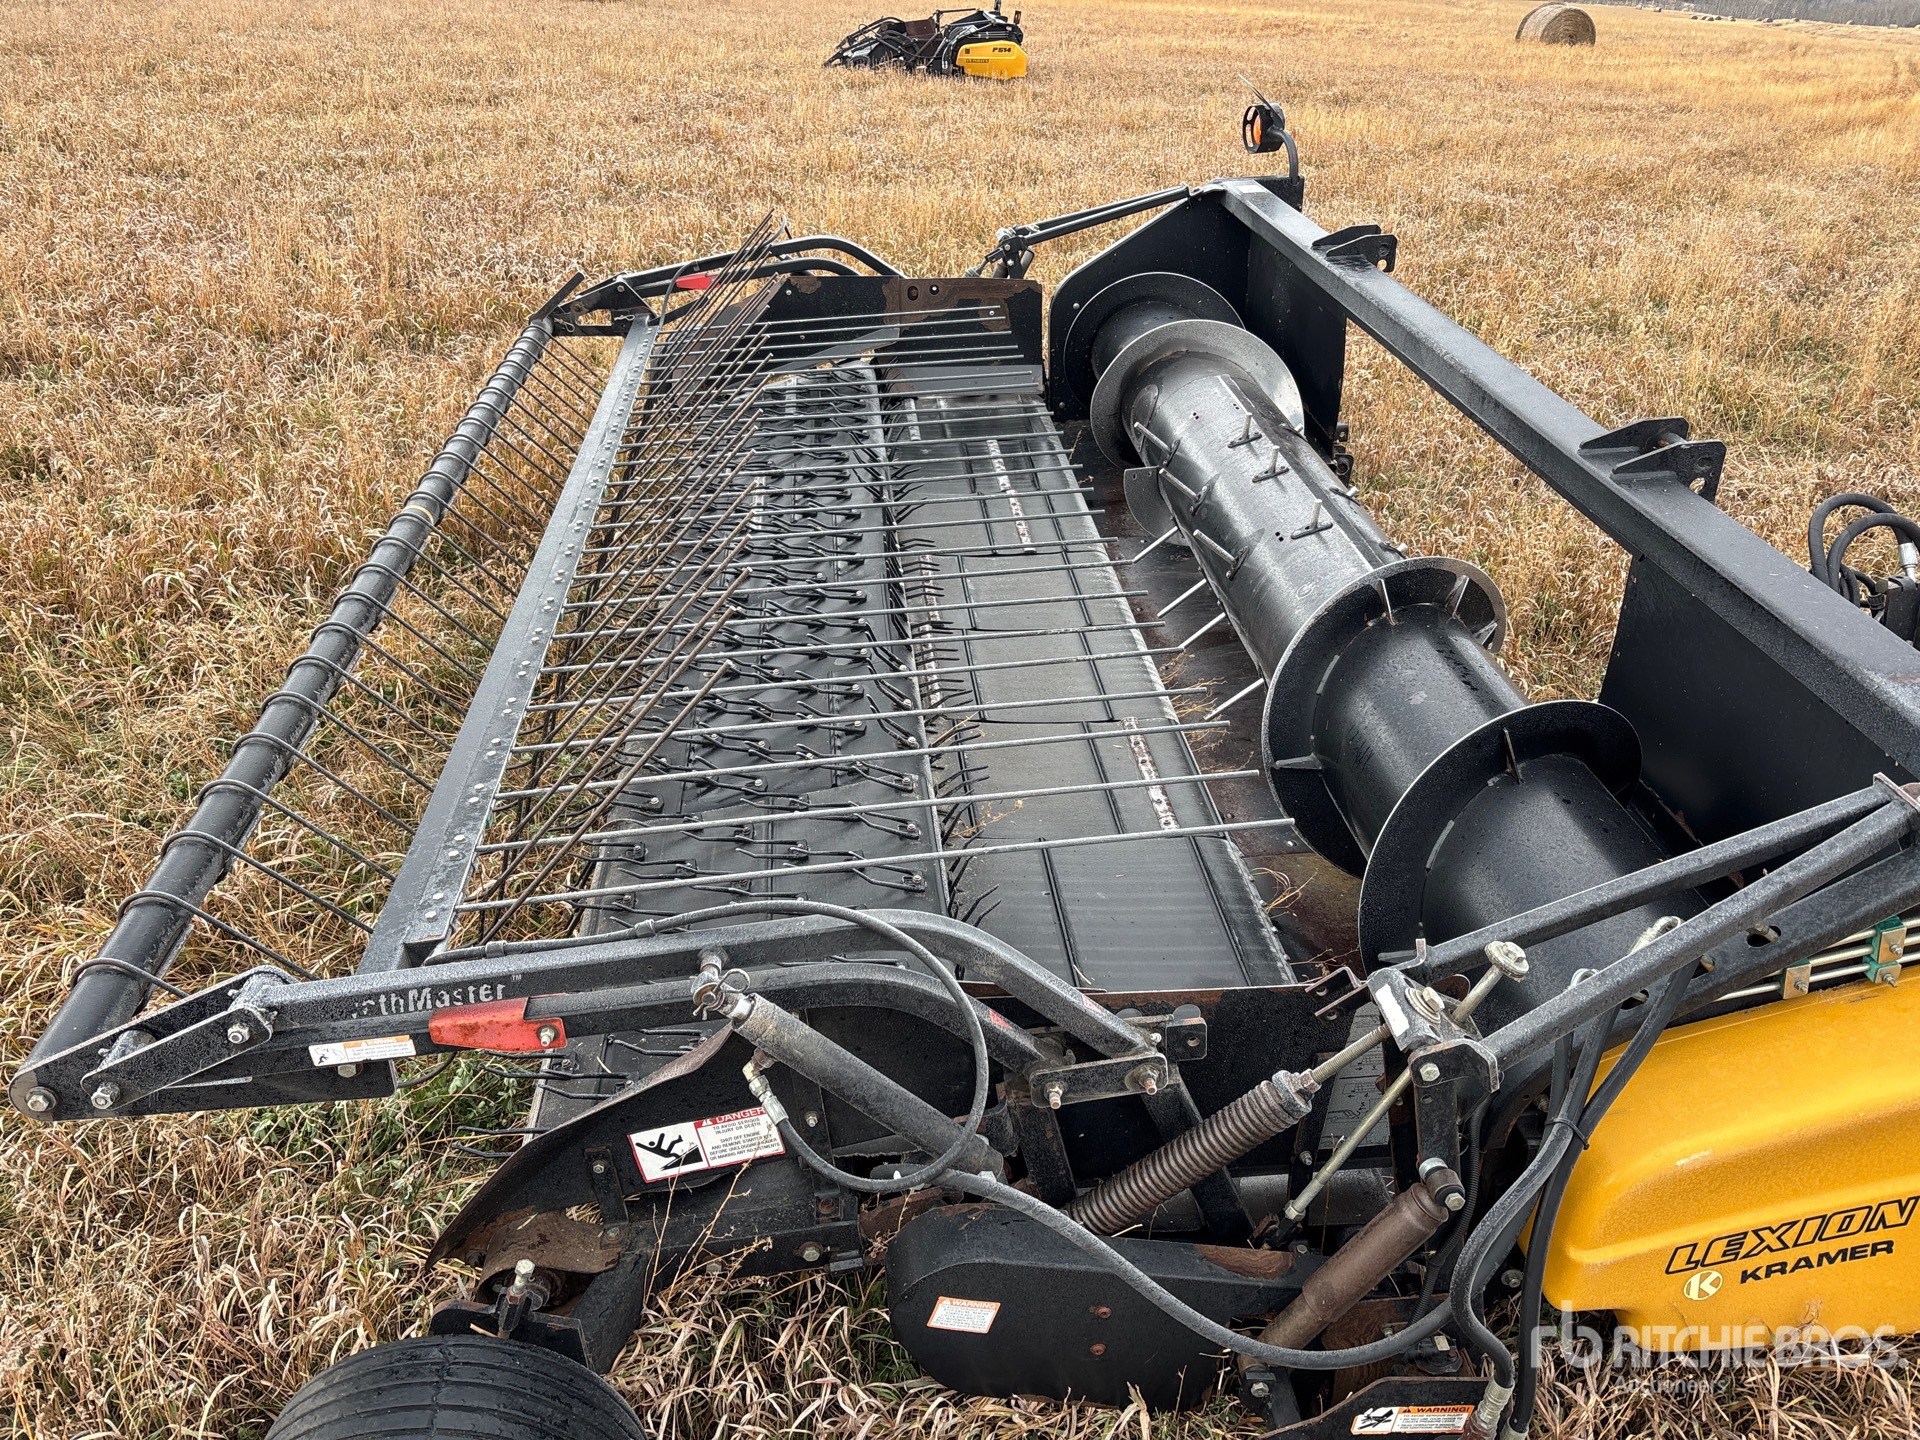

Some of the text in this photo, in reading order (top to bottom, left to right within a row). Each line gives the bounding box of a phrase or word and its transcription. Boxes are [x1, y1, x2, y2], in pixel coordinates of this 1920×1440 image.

[716, 1107, 766, 1123] DANGER
[1665, 1195, 1920, 1275] LEXION
[1740, 1240, 1894, 1284] KRAMER
[952, 1300, 996, 1310] WARNING
